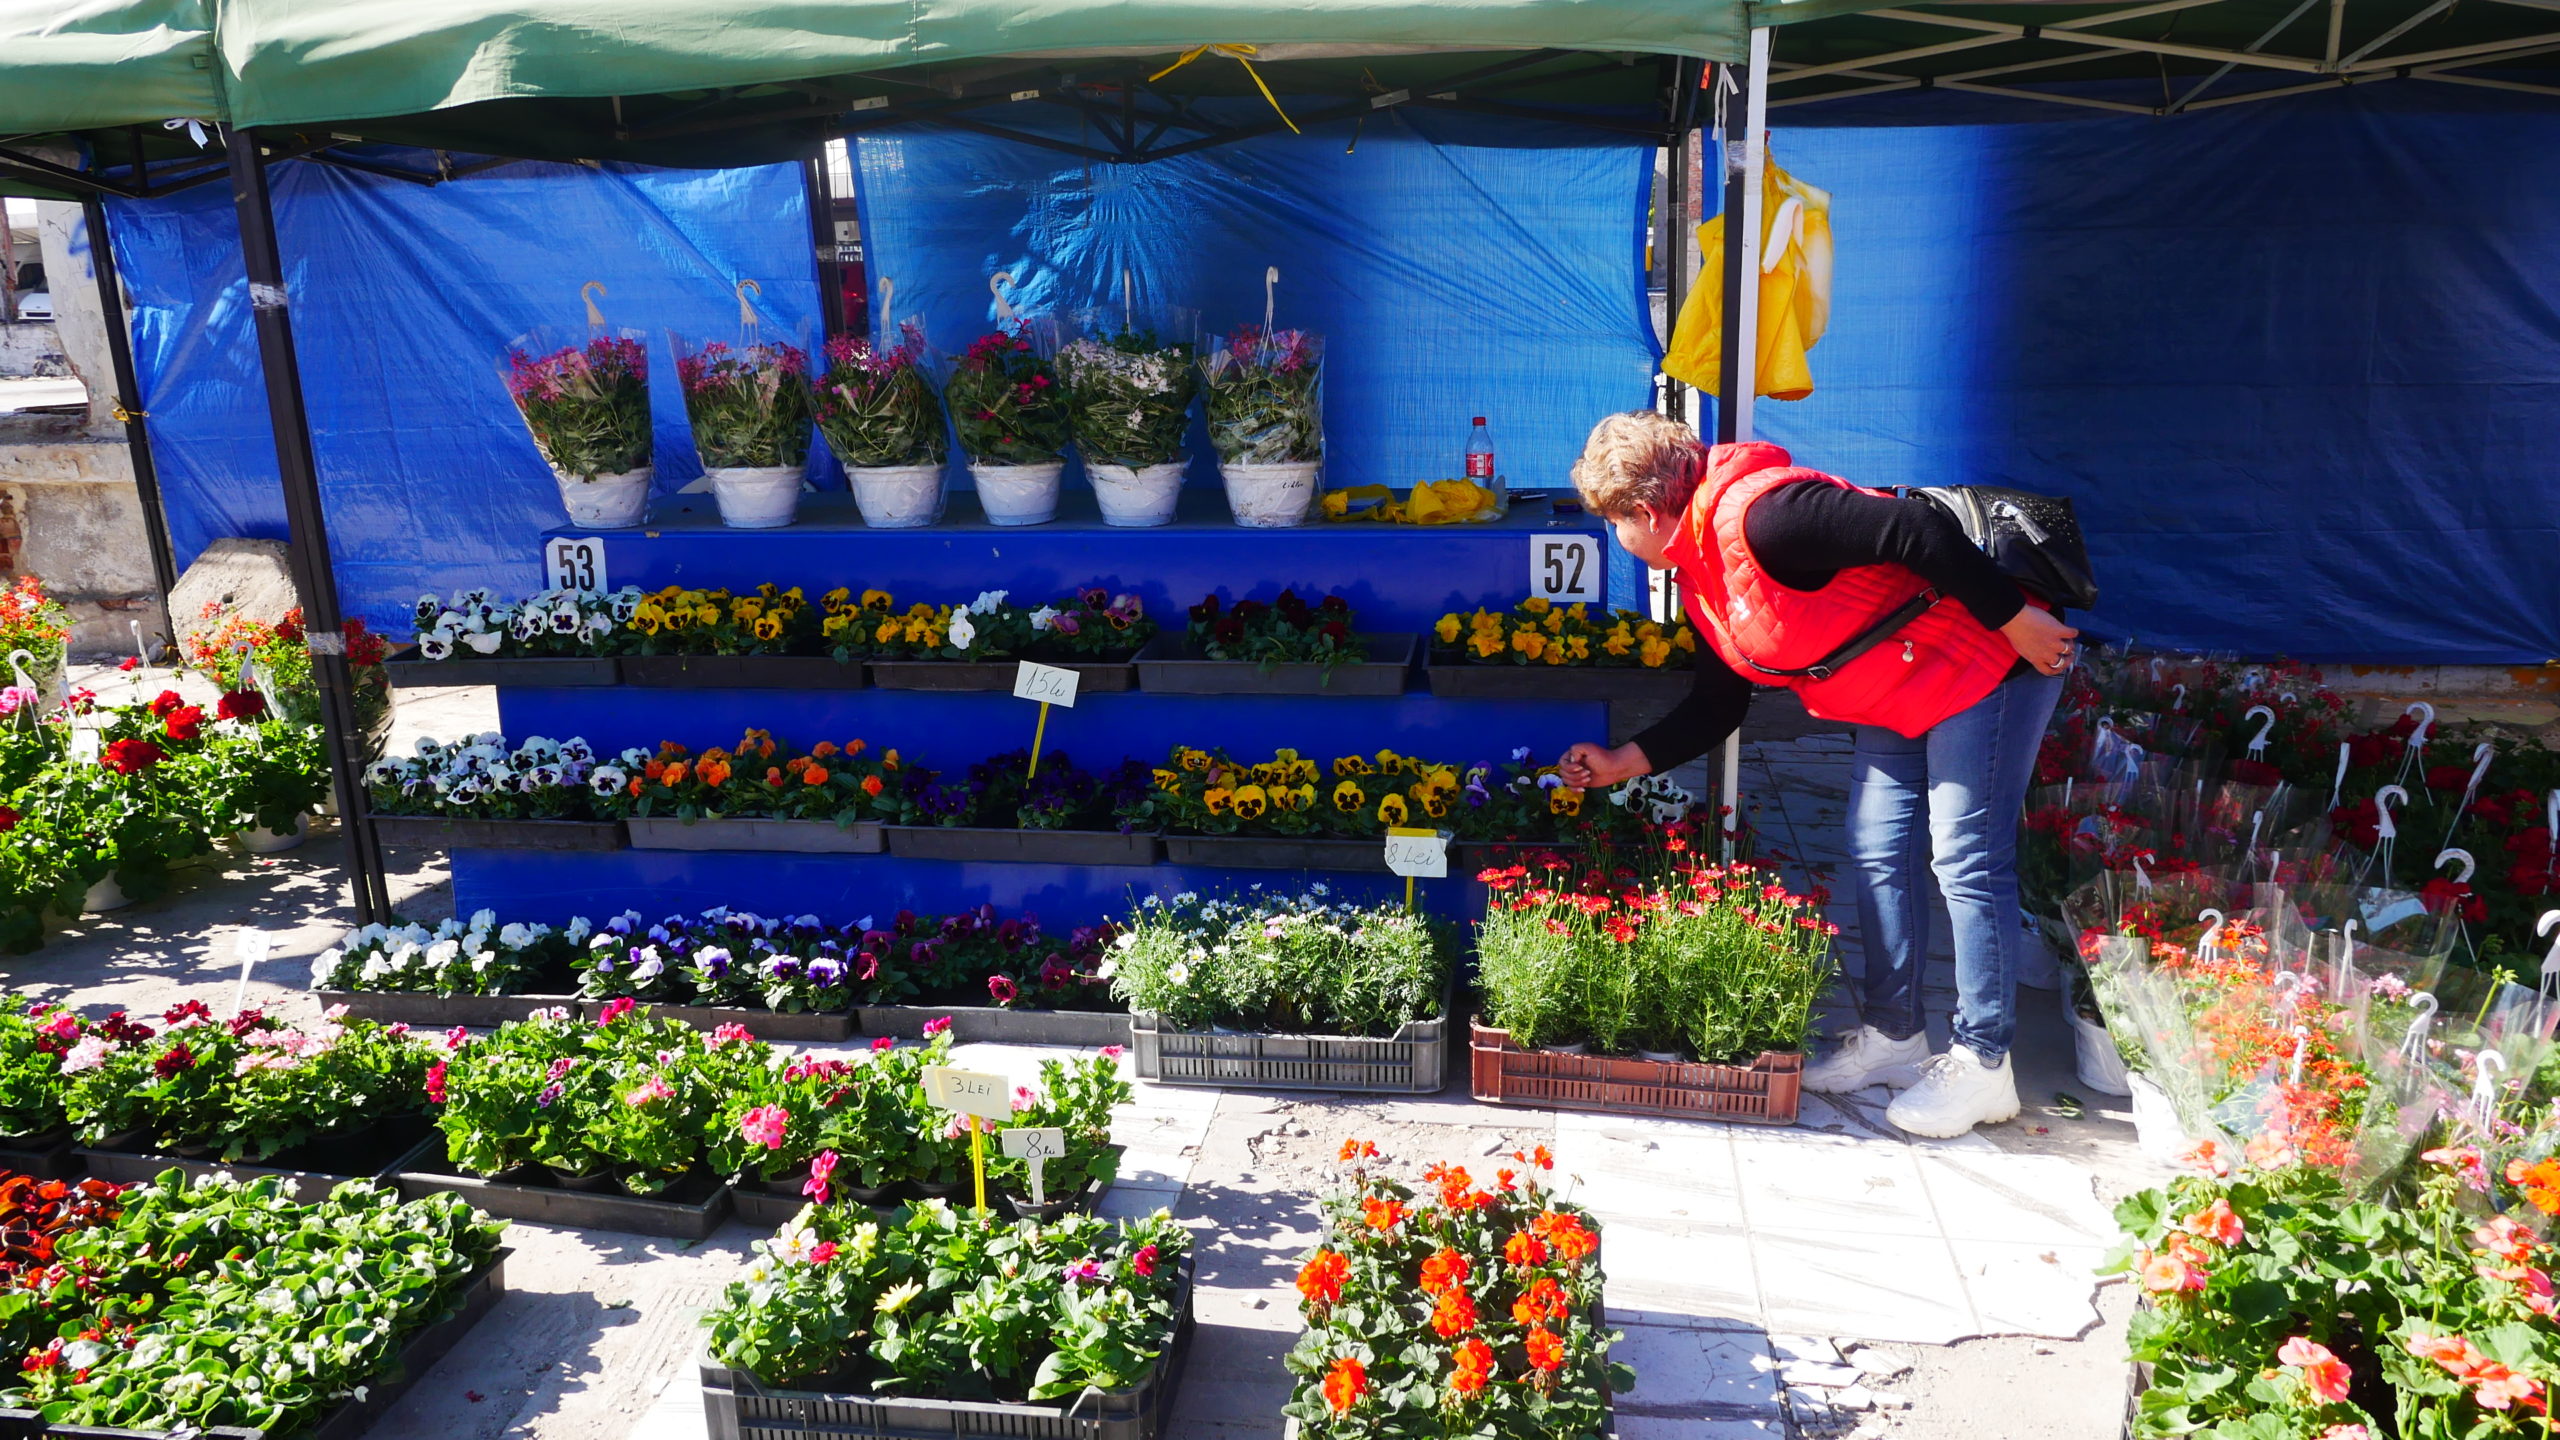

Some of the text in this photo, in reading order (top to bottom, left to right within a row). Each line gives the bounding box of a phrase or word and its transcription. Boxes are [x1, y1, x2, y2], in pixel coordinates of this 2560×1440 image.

[558, 544, 596, 592] 53
[1544, 543, 1586, 594] 52
[1387, 843, 1399, 865] 8
[1026, 1131, 1042, 1158] 8
